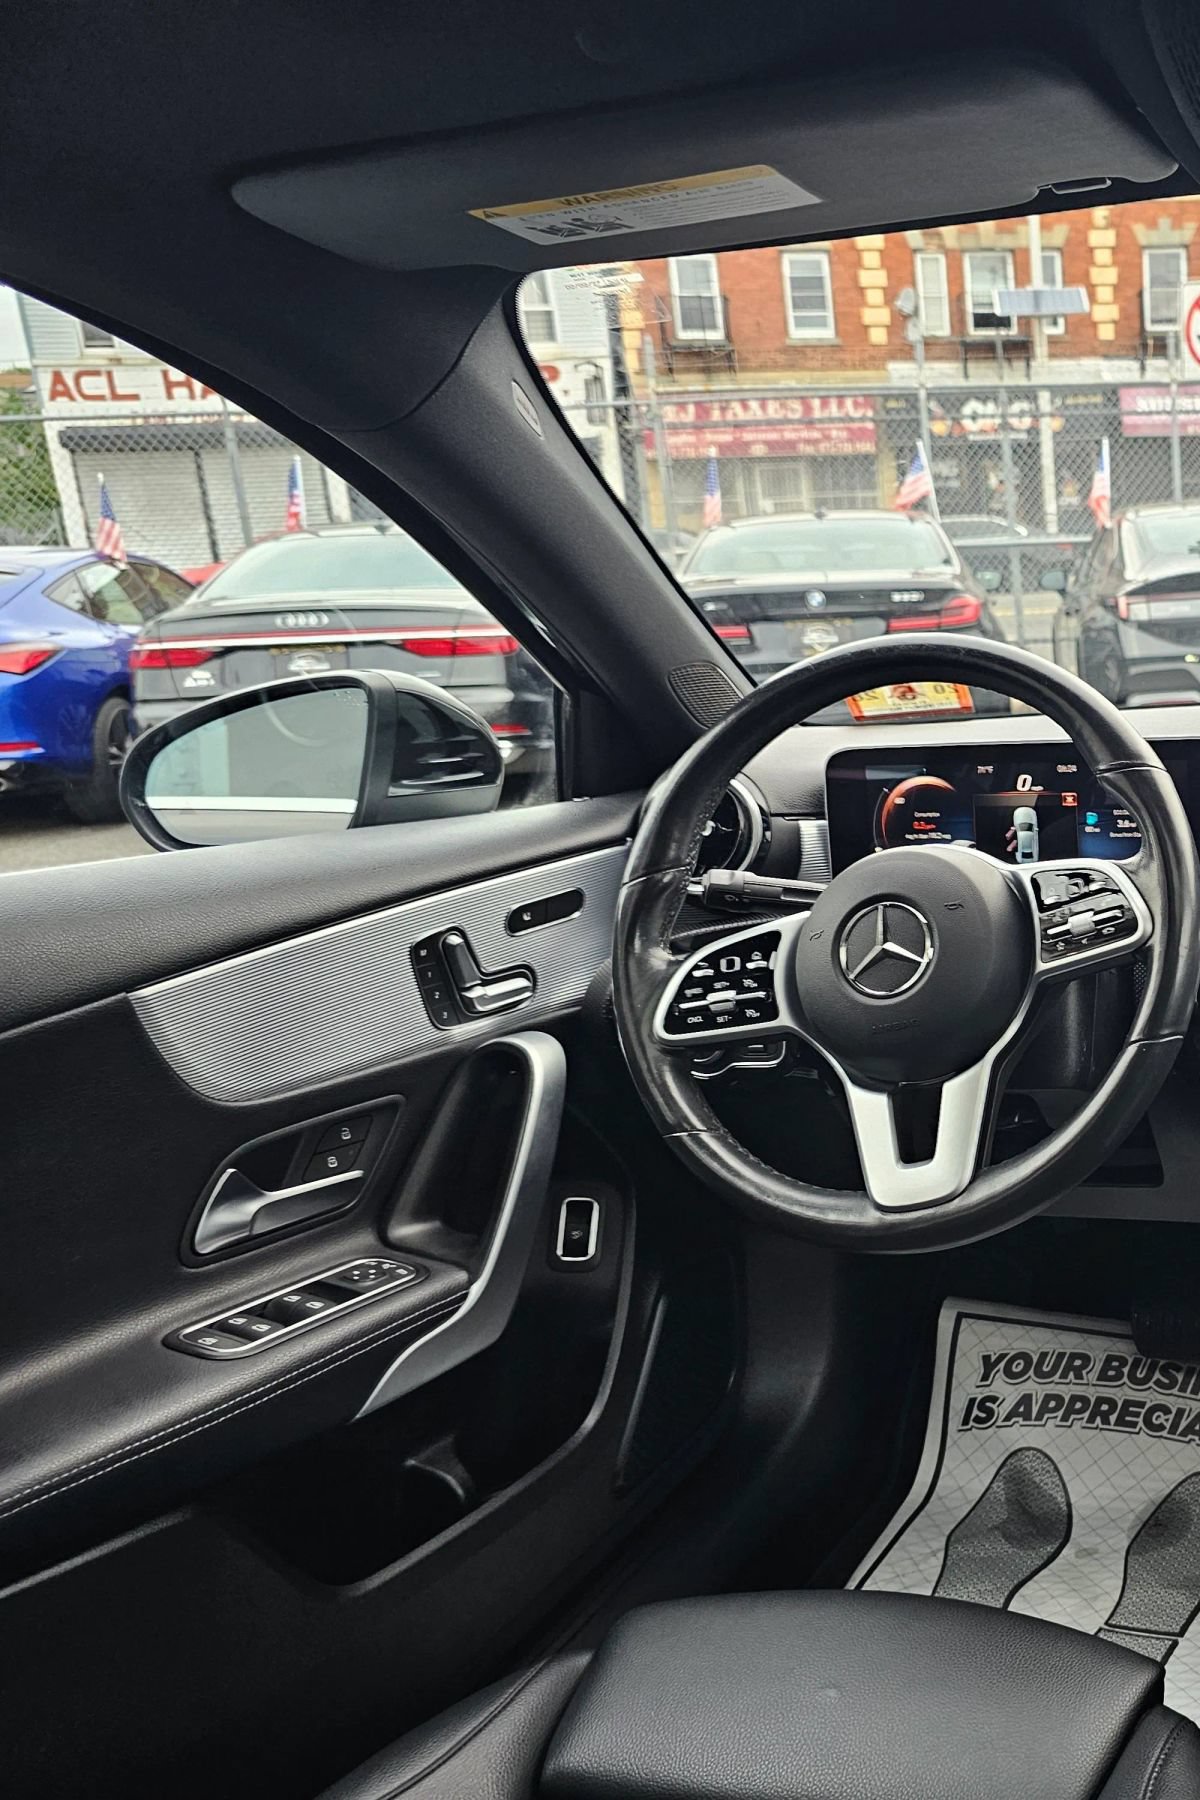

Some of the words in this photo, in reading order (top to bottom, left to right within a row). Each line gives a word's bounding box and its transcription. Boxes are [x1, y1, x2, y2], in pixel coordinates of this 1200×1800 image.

[560, 182, 677, 206] WARNING
[50, 370, 141, 402] ACL
[708, 397, 803, 421] TAXES
[1016, 774, 1033, 792] 0
[978, 1350, 1091, 1386] YOUR
[961, 1394, 1001, 1430] IS
